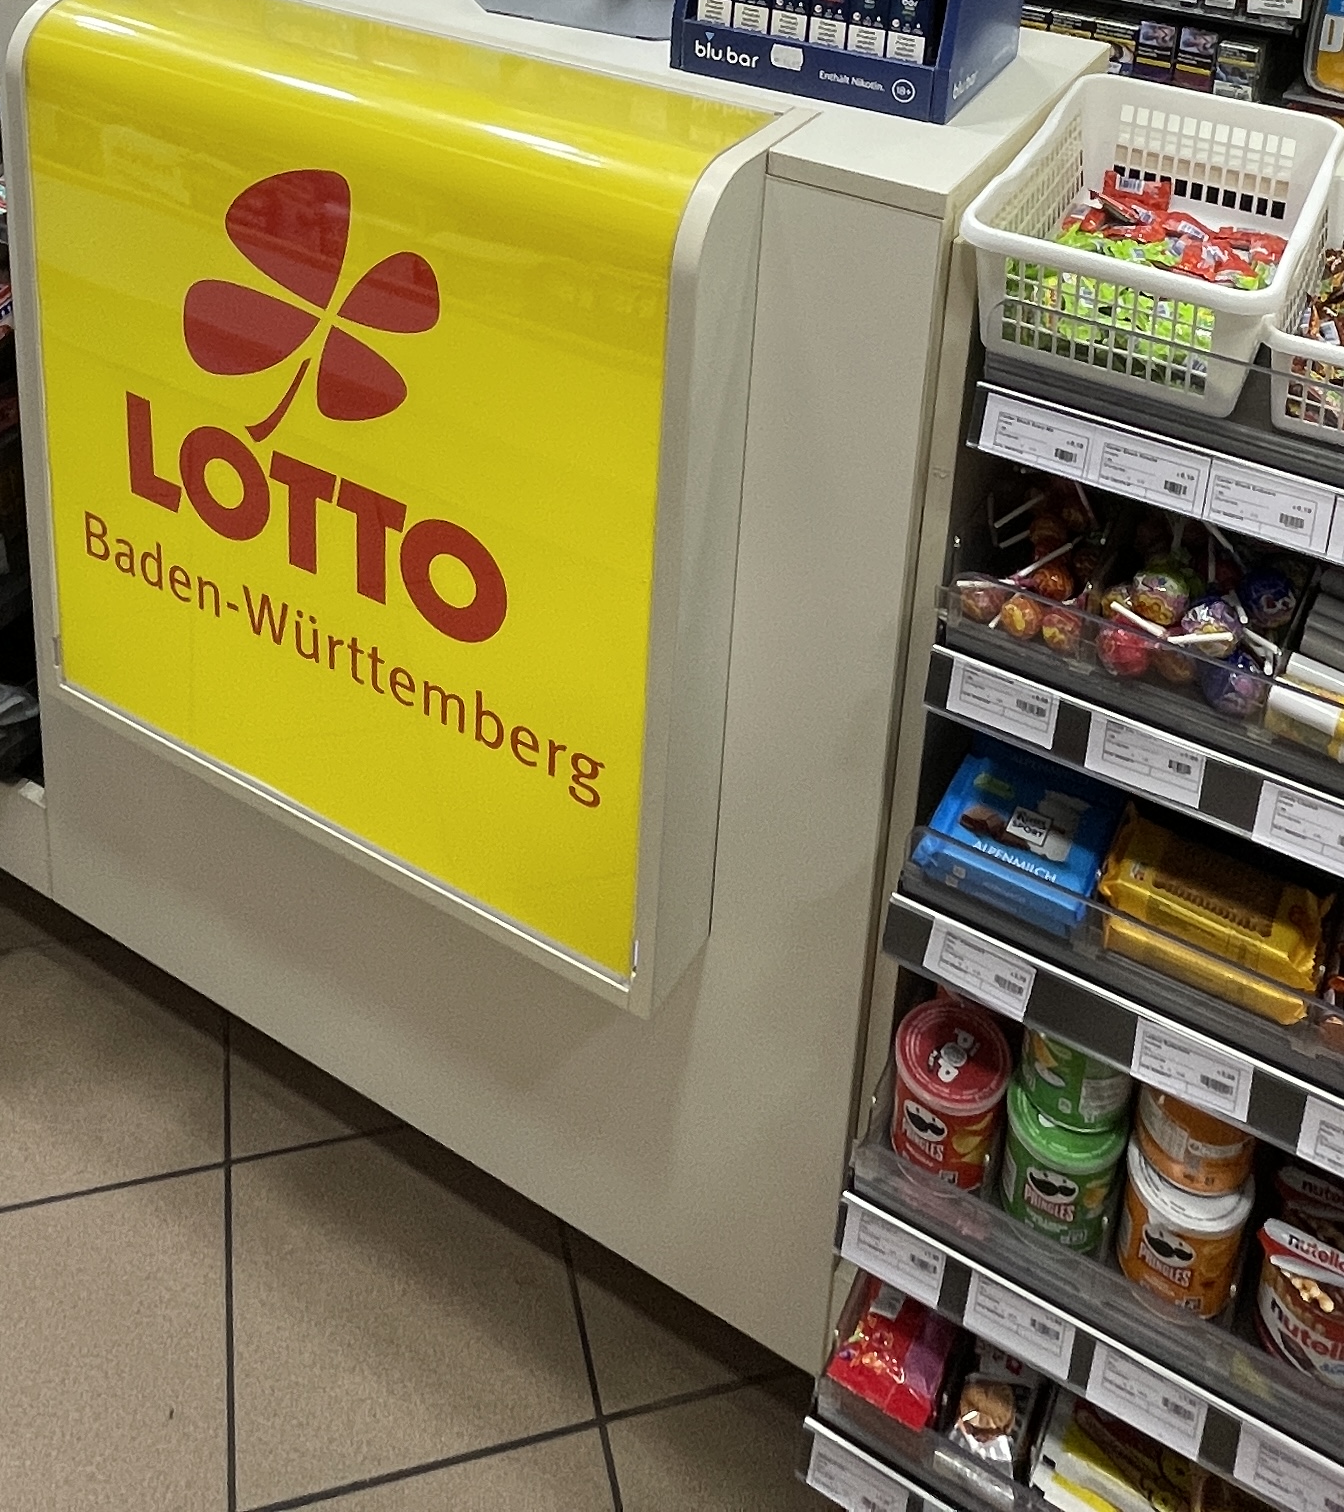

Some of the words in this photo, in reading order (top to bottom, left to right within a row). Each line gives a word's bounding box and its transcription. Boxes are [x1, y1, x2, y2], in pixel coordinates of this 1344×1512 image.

[819, 70, 850, 86] Enthält
[851, 75, 885, 92] Nikotin.
[125, 390, 508, 644] LOTTO
[83, 510, 607, 809] Baden-Württemberg
[971, 838, 1058, 883] ALPENMILCH
[1137, 1246, 1194, 1287] PRINGLES
